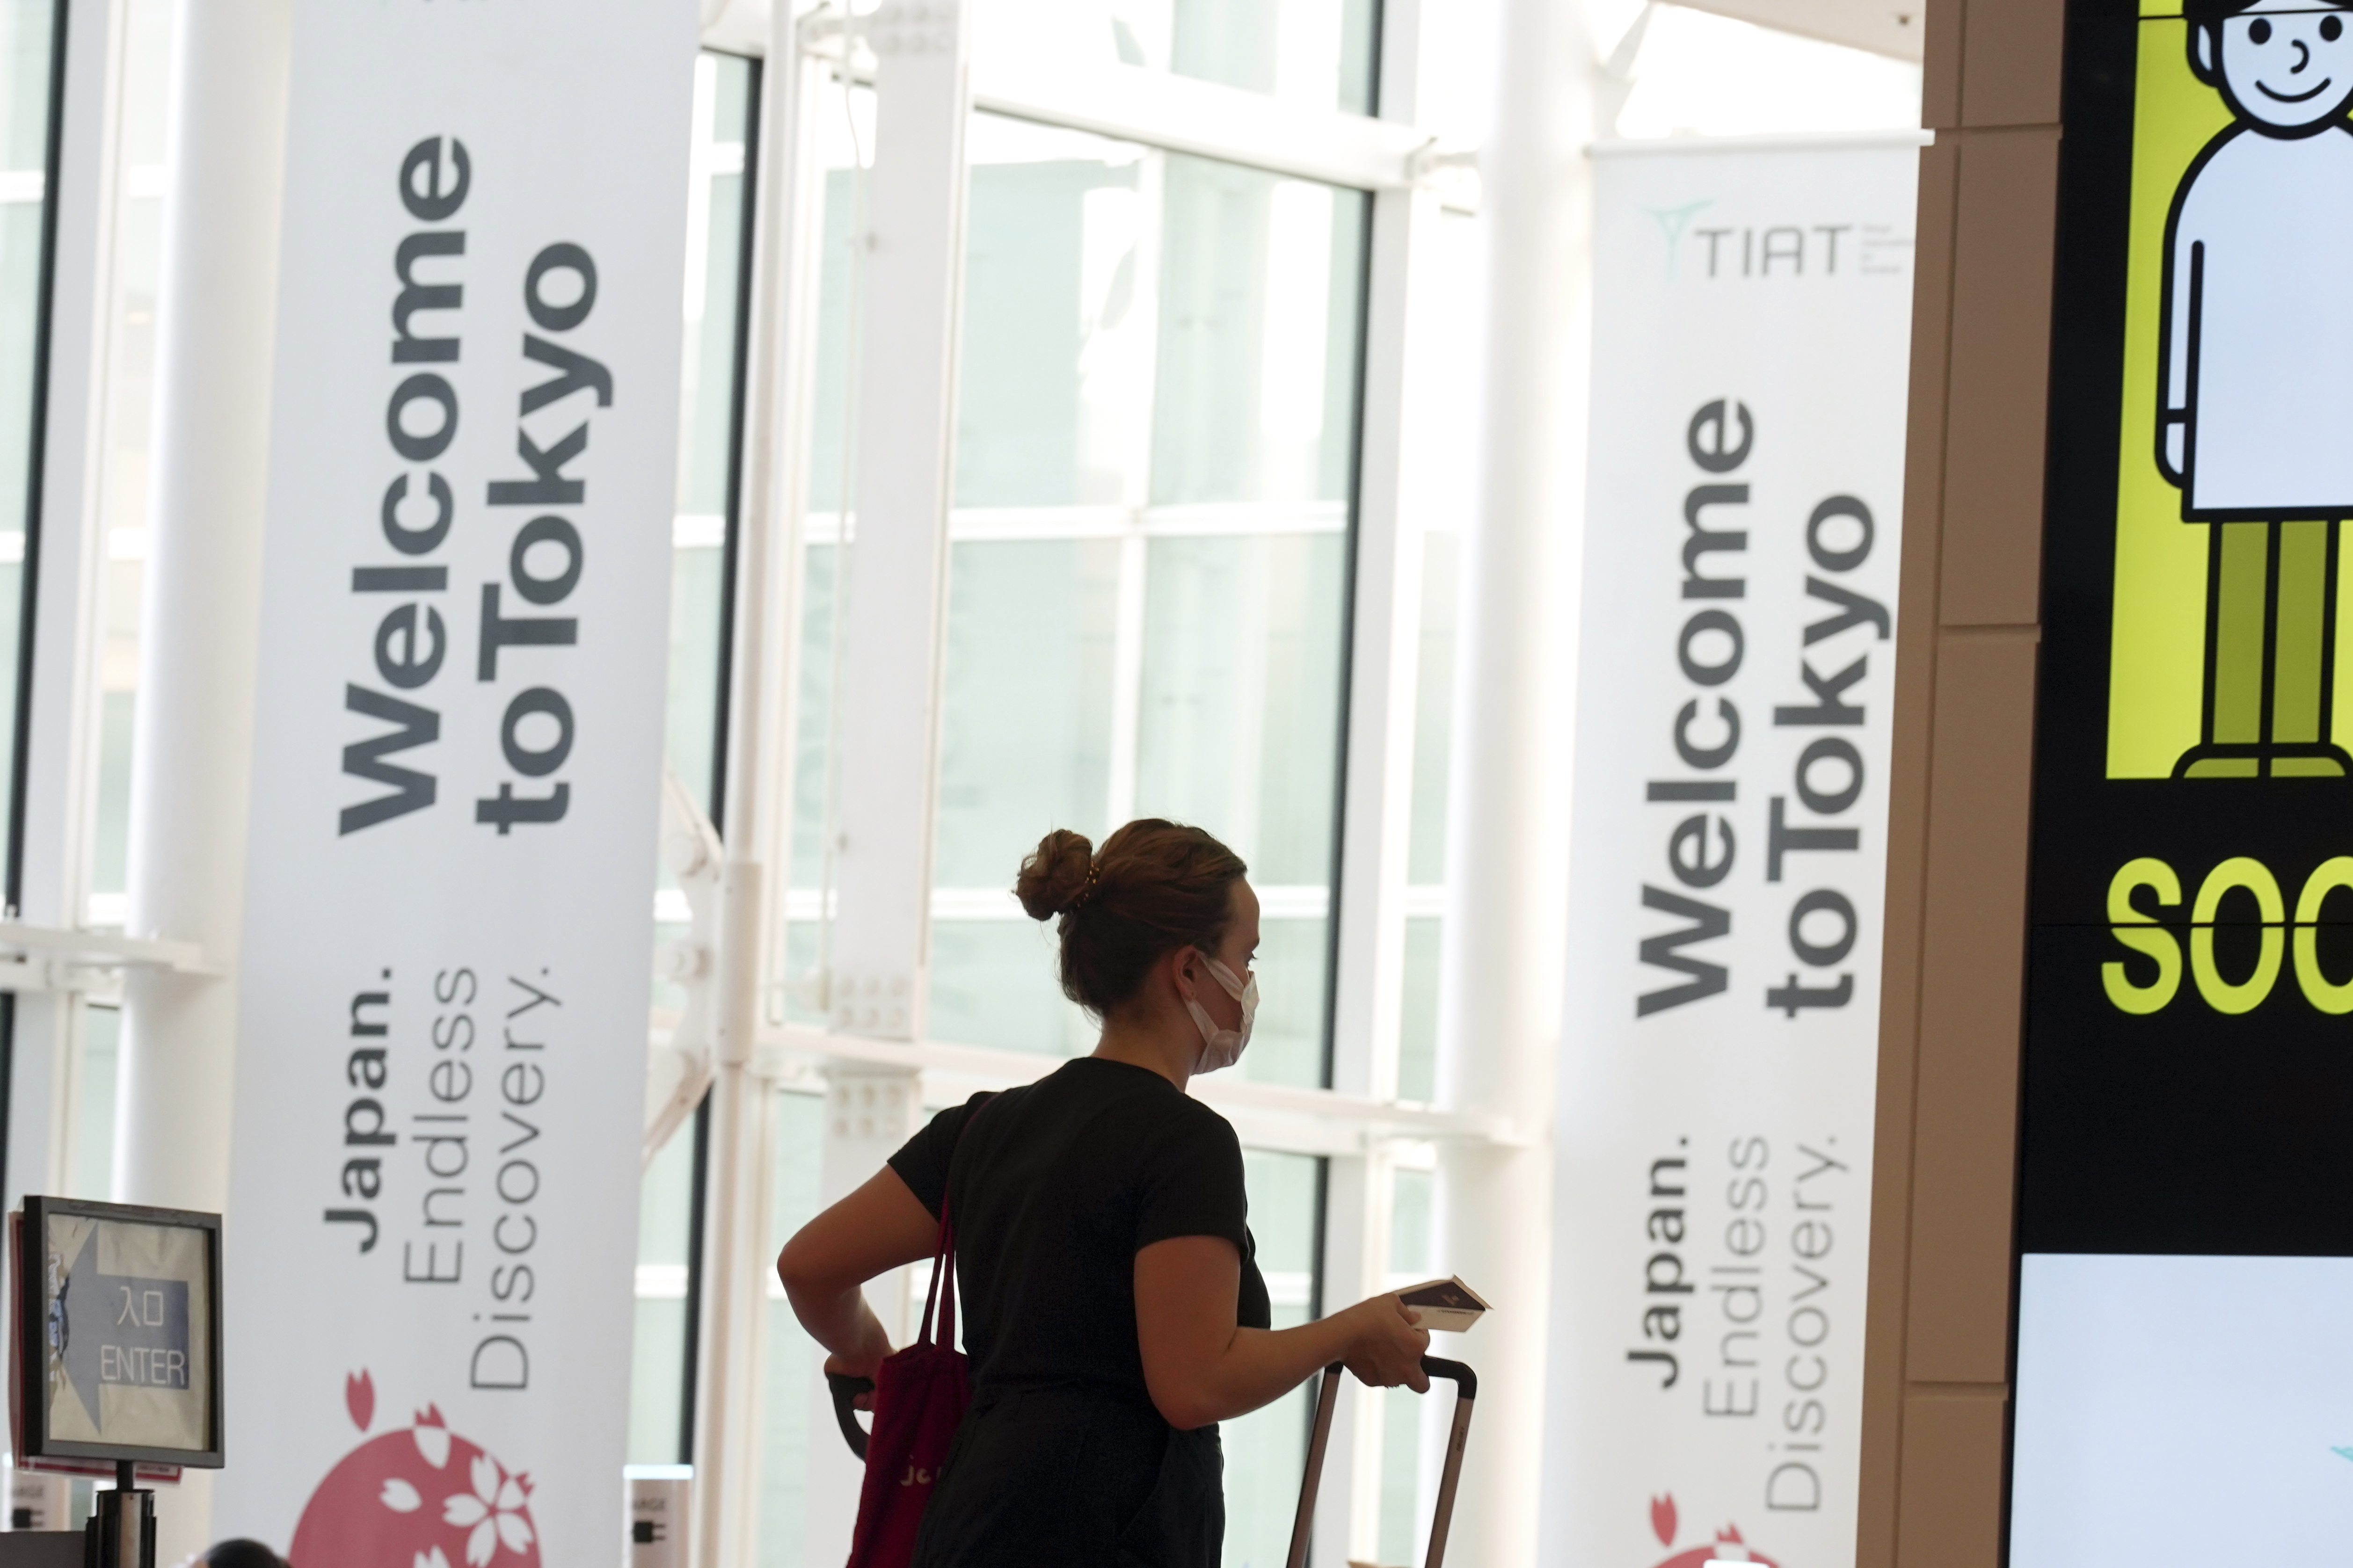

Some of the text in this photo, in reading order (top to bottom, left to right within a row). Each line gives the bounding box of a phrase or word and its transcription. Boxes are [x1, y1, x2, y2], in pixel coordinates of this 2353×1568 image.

[1693, 223, 1853, 279] TIAT
[337, 135, 472, 838] Welcome
[474, 241, 614, 836] to Tokyo
[1635, 398, 1755, 1020] Welcome
[1765, 493, 1891, 1020] to Tokyo
[323, 968, 397, 1255] Japan.
[402, 966, 478, 1285] Endless
[468, 967, 562, 1392] Discovery.
[1625, 1137, 1696, 1391] Japan.
[101, 1344, 186, 1387] ENTER
[117, 1285, 164, 1327] 入口
[1701, 1135, 1770, 1420] Endless
[1763, 1135, 1850, 1514] Discovery.
